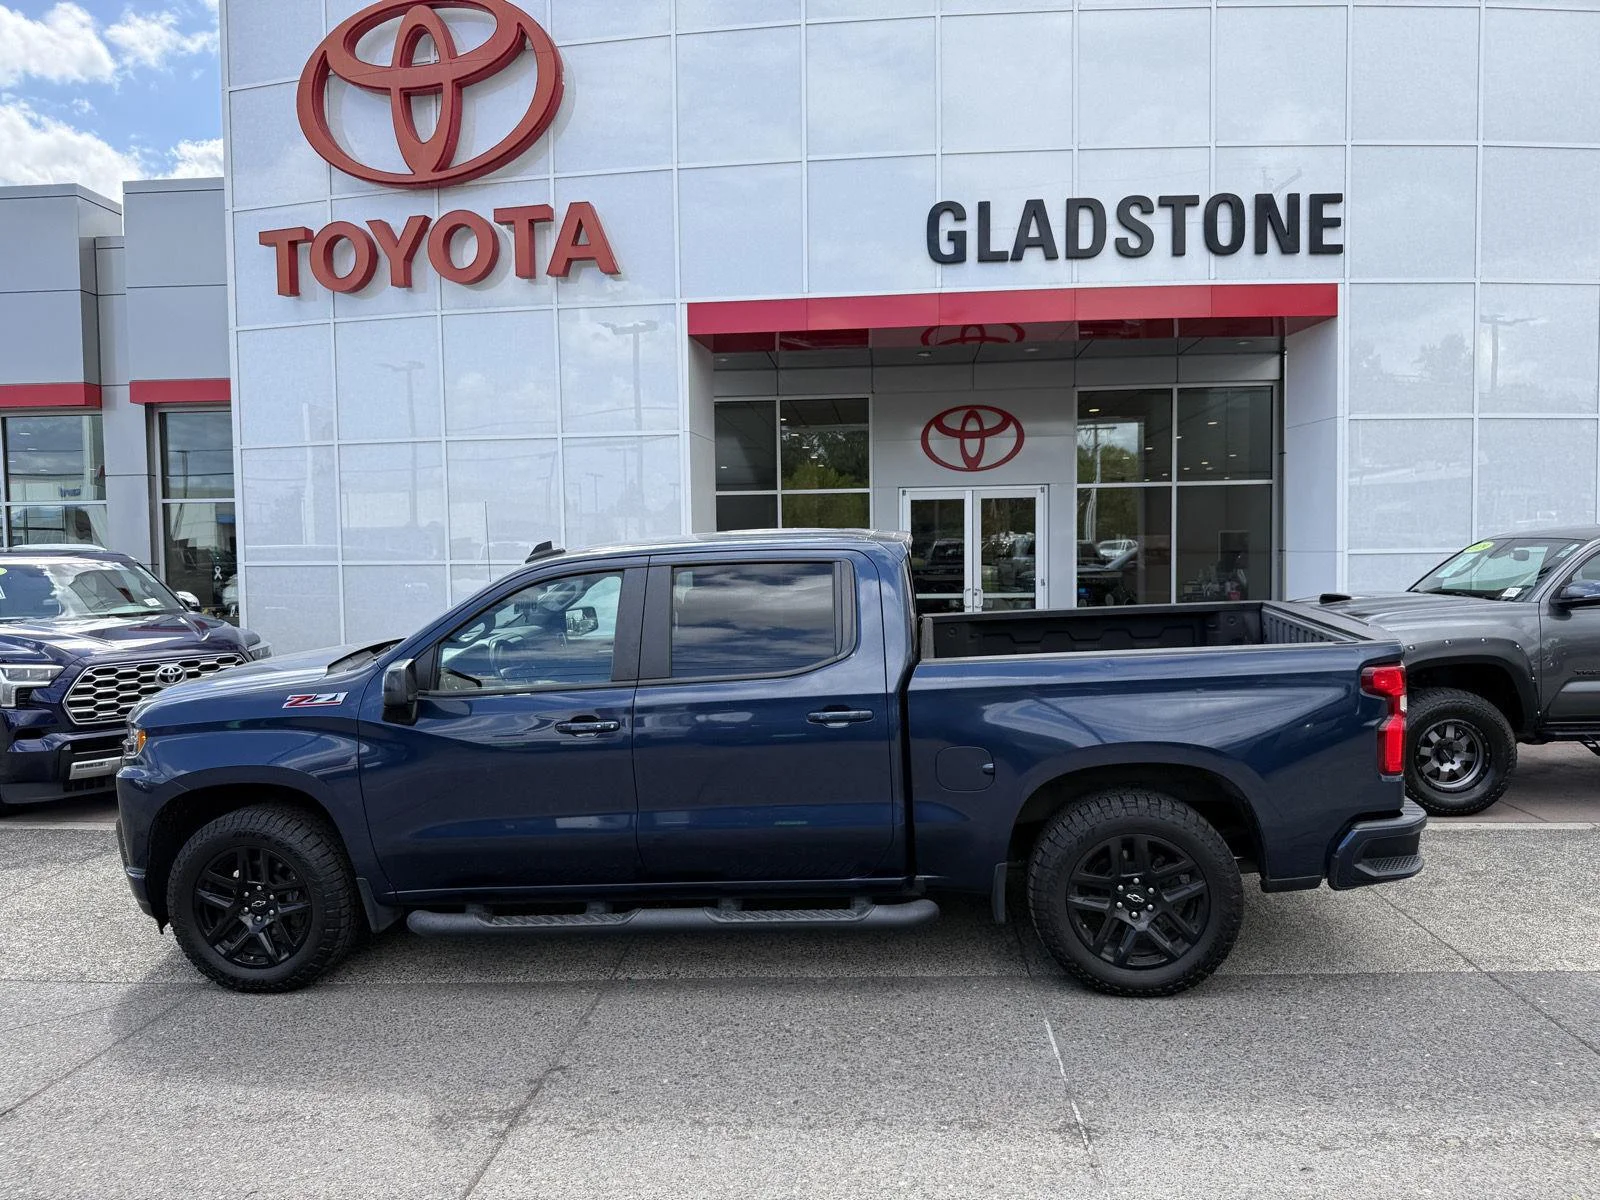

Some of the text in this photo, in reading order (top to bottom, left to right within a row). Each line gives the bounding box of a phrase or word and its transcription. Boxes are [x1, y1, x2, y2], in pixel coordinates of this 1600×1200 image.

[259, 201, 621, 297] TOYOTA
[927, 193, 1343, 264] GLADSTONE
[282, 691, 348, 708] Z71
